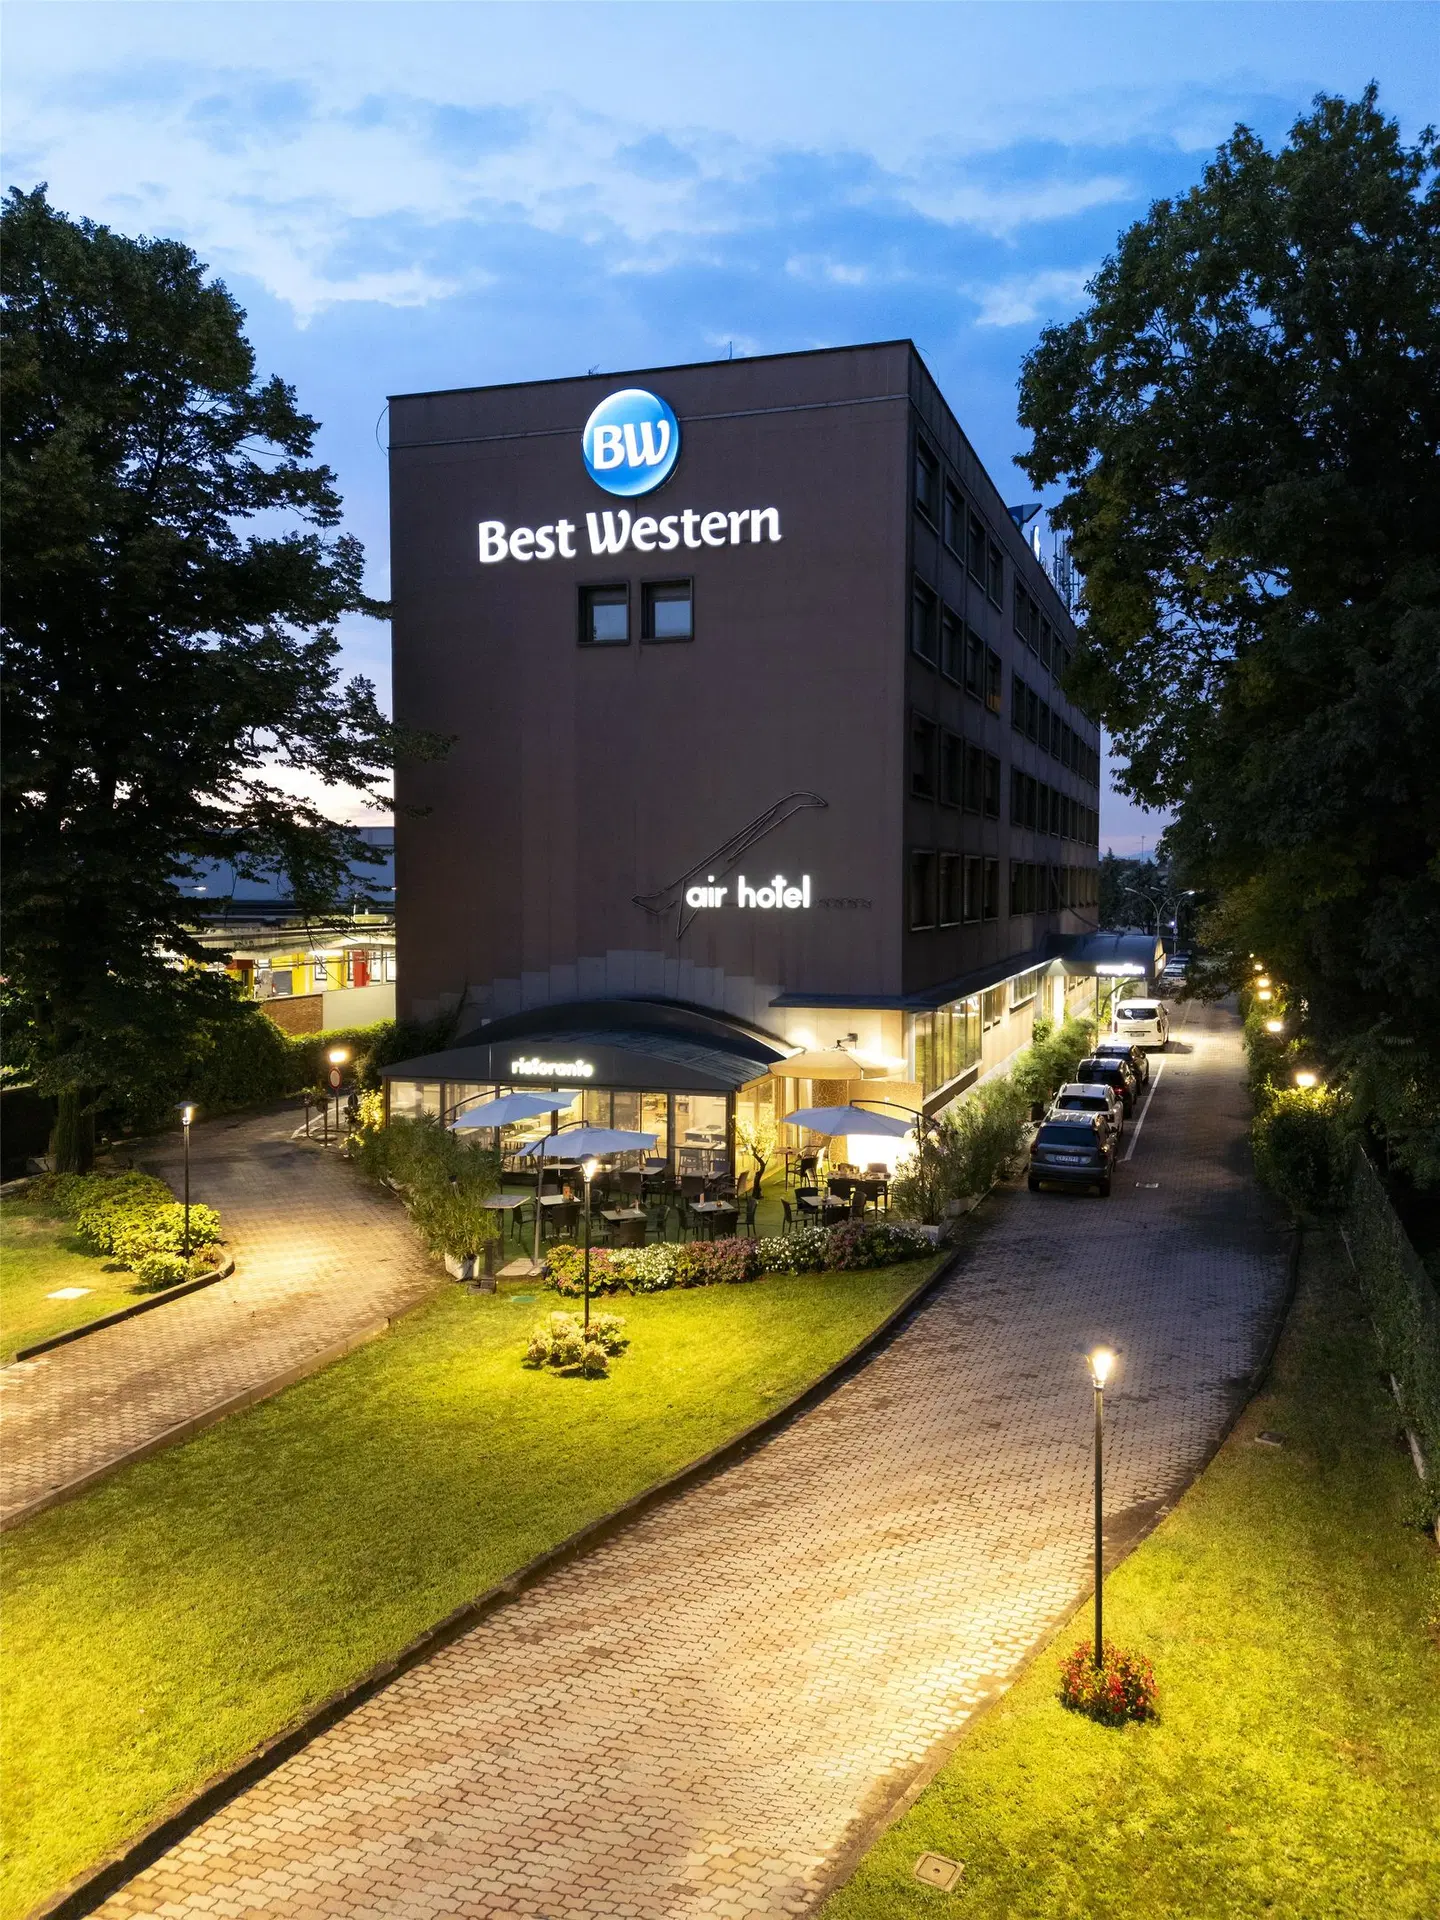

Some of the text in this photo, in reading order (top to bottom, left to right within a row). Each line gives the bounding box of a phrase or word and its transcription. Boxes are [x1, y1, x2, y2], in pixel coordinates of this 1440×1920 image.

[593, 419, 670, 470] BW
[478, 507, 782, 564] Best Western
[685, 874, 811, 909] air hotel
[511, 1056, 594, 1078] ristorante
